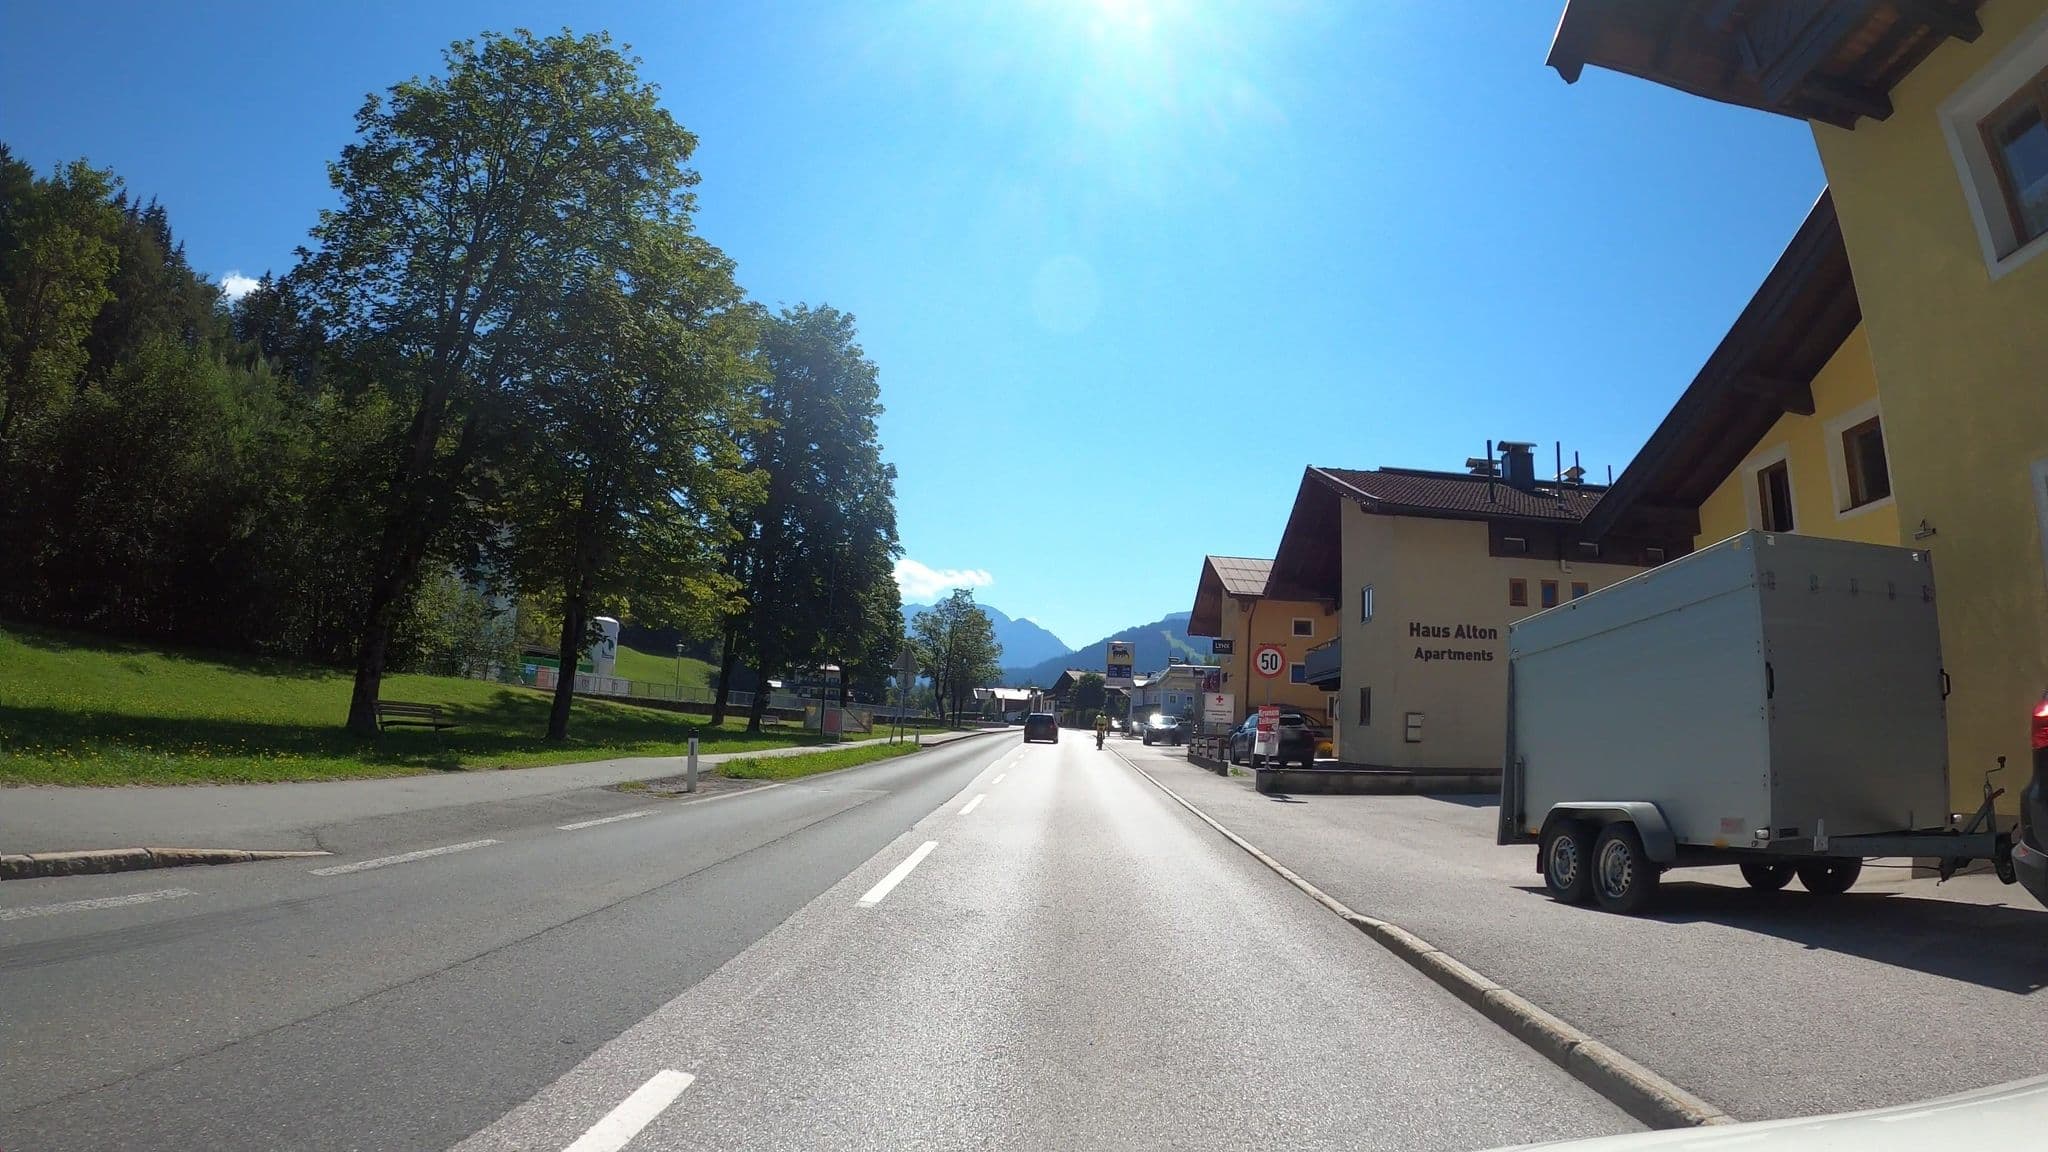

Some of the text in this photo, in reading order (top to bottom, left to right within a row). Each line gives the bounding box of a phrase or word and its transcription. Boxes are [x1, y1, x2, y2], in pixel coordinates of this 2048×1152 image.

[1409, 622, 1498, 640] Haus Alton
[1261, 654, 1278, 671] 50
[1414, 647, 1494, 662] Apartments
